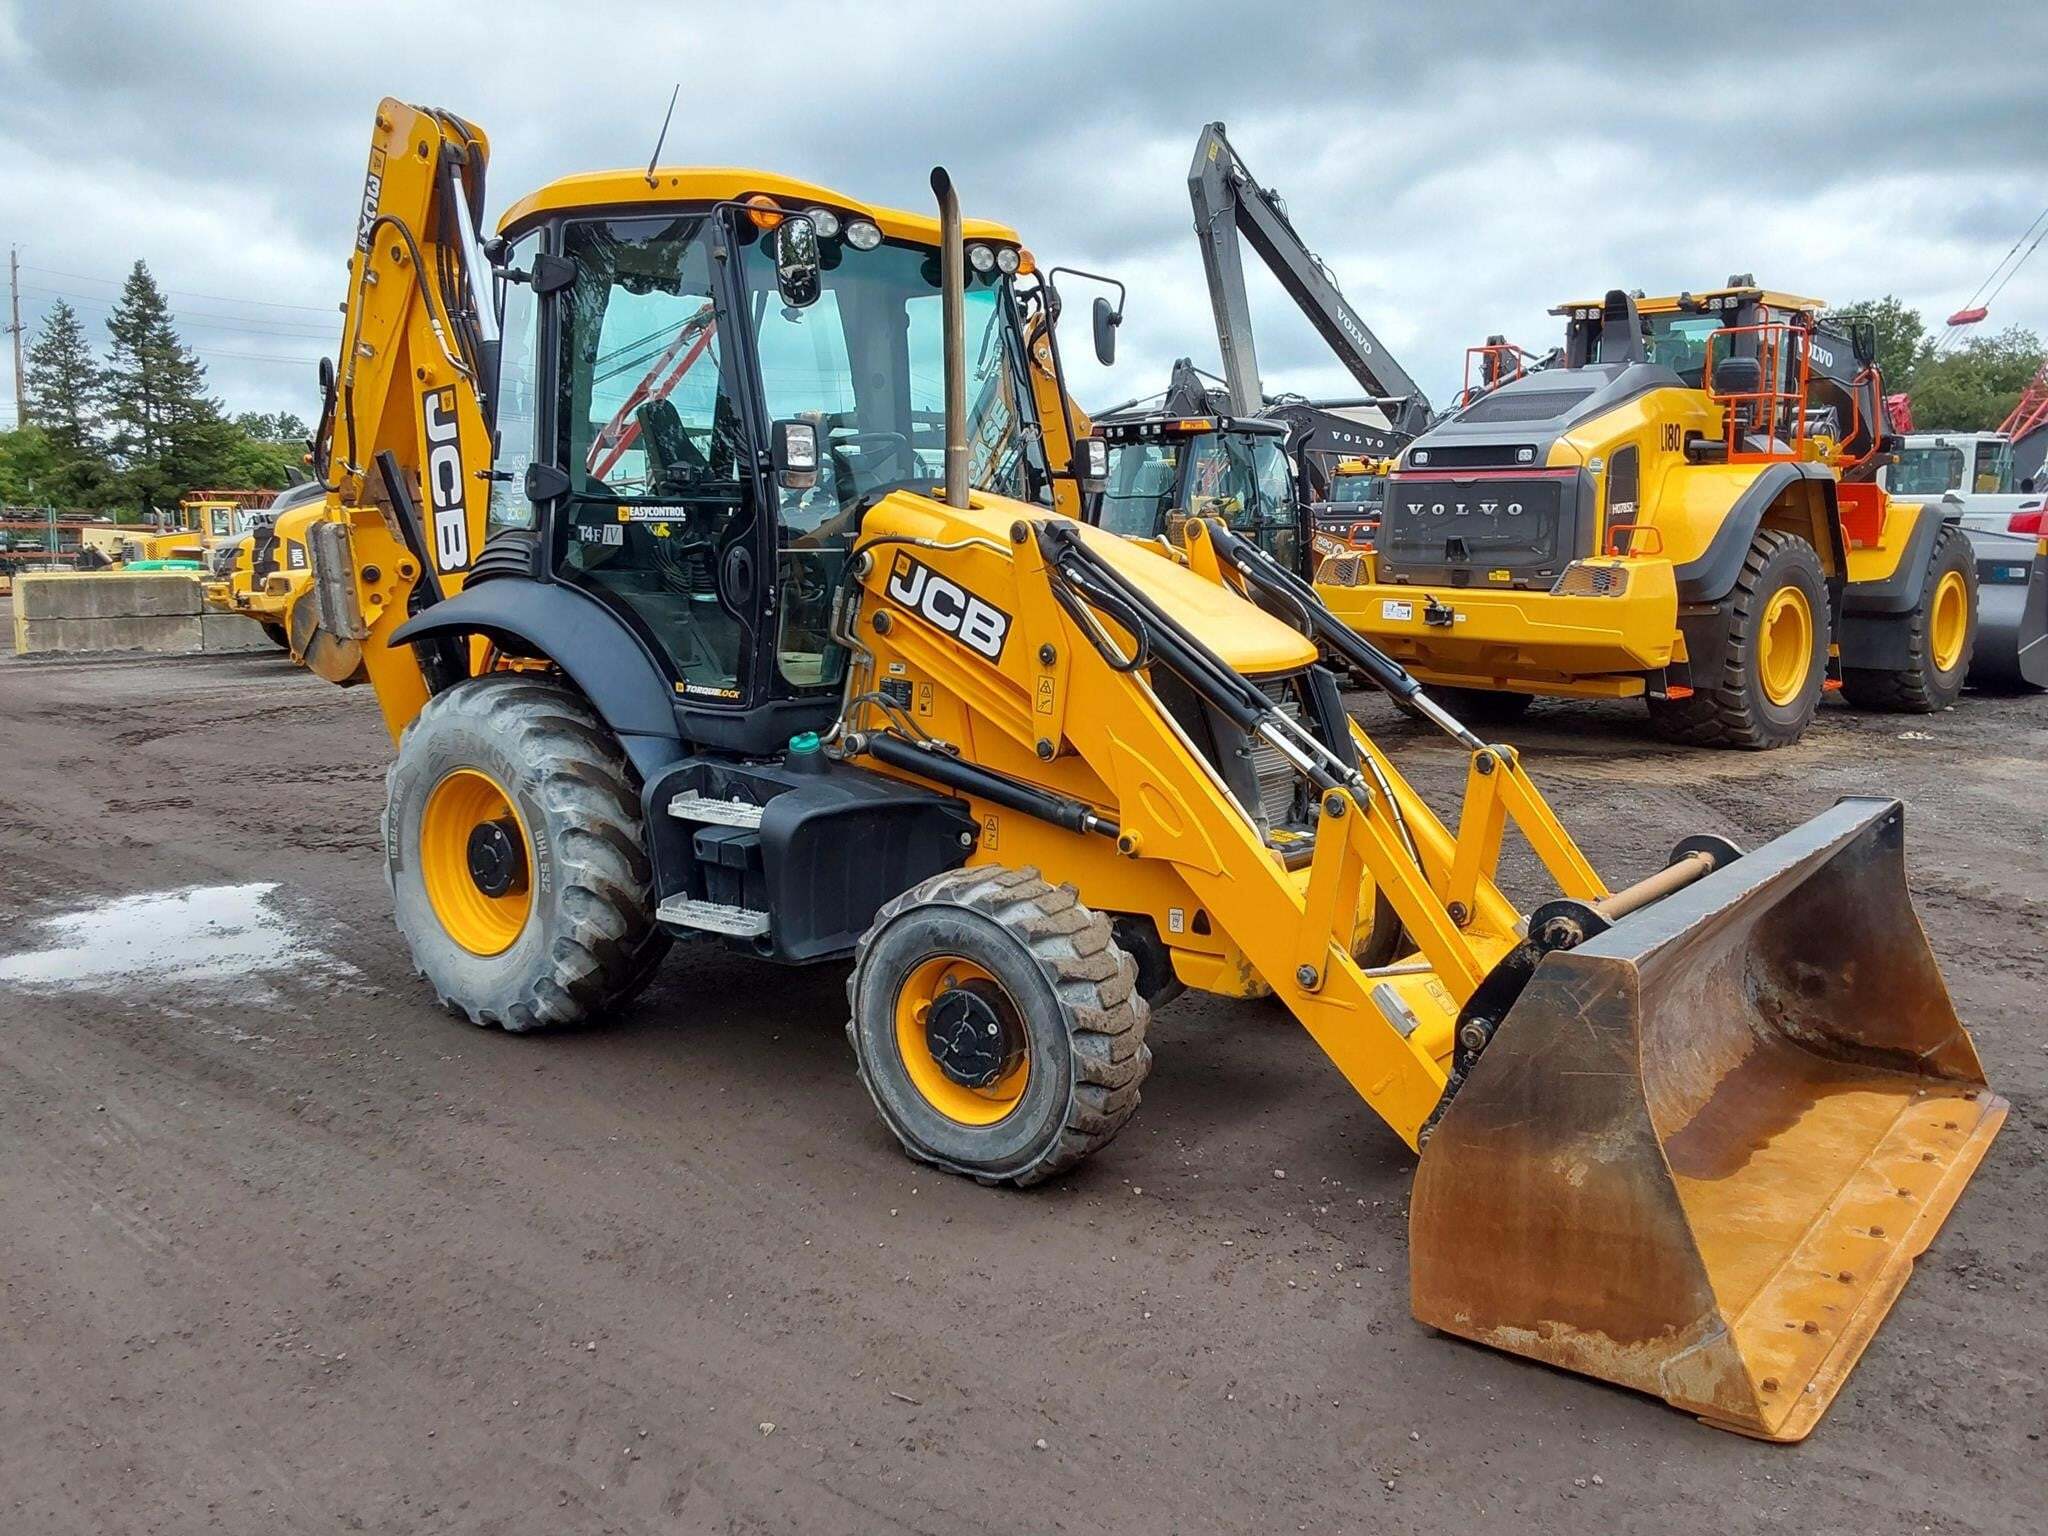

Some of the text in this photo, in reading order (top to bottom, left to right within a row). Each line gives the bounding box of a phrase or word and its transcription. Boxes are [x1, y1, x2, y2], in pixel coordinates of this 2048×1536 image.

[1336, 305, 1372, 355] VOLVO
[1797, 335, 1833, 368] VLVO
[968, 398, 1010, 487] CASE
[1332, 431, 1384, 448] VOLVO
[1660, 423, 1681, 452] L180
[425, 393, 468, 571] JCB
[629, 506, 686, 520] EASYCONTROL
[1407, 503, 1523, 516] VOLVO
[291, 549, 304, 566] L70H
[890, 565, 1006, 657] JCB
